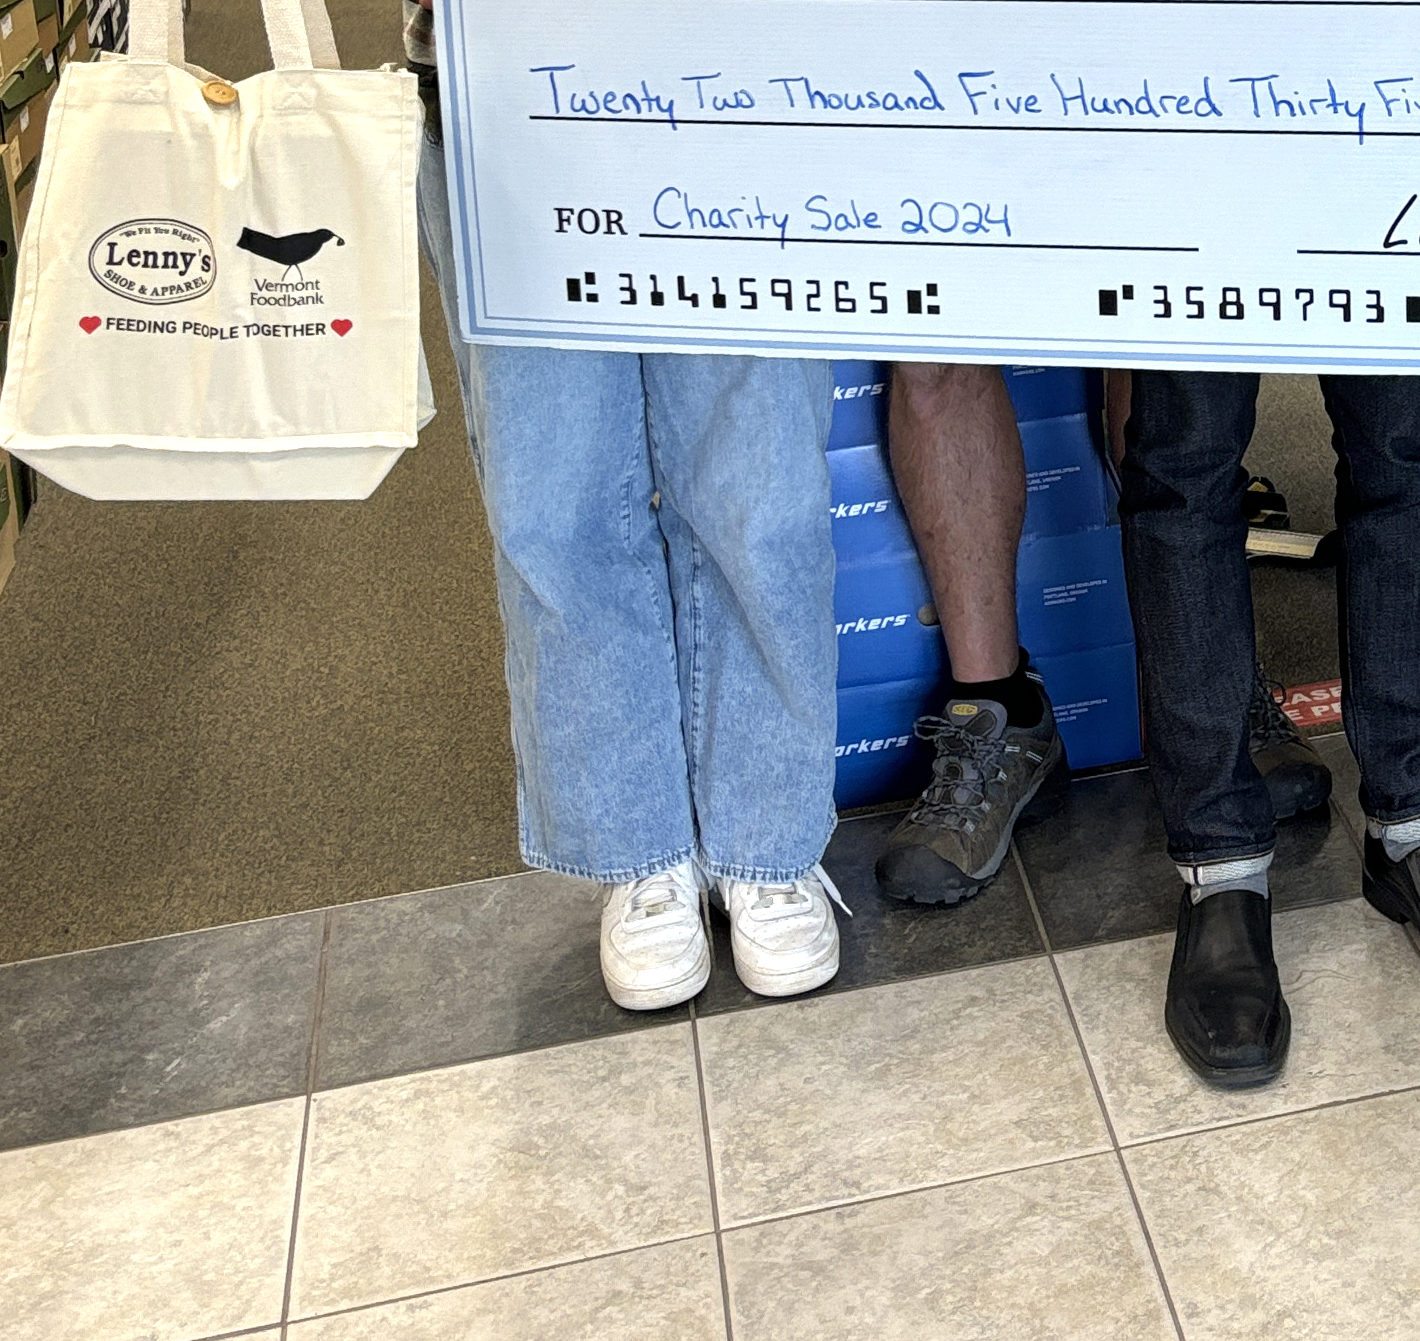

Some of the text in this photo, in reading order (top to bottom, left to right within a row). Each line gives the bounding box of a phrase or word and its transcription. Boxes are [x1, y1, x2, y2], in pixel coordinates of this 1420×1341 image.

[530, 65, 678, 130] Twenty
[682, 72, 755, 112] Two
[769, 70, 945, 113] Thousand
[958, 71, 1042, 117] Five
[1050, 74, 1223, 120] Hundred
[1230, 74, 1367, 145] Thirty
[554, 208, 628, 236] FOR
[653, 187, 1013, 249] Charity Sale 2024
[105, 242, 211, 276] Lenny's
[104, 269, 207, 296] SHOE & APPAREL
[253, 278, 321, 293] Vermont
[619, 272, 889, 315] 314159265
[250, 292, 324, 307] Foodbank
[1153, 286, 1385, 323] 3589793
[106, 317, 326, 340] FEEDING PEOPLE TOGETHER
[834, 383, 884, 400] kers
[829, 500, 889, 519] kers
[835, 614, 910, 635] rkers
[835, 735, 911, 757] orkers
